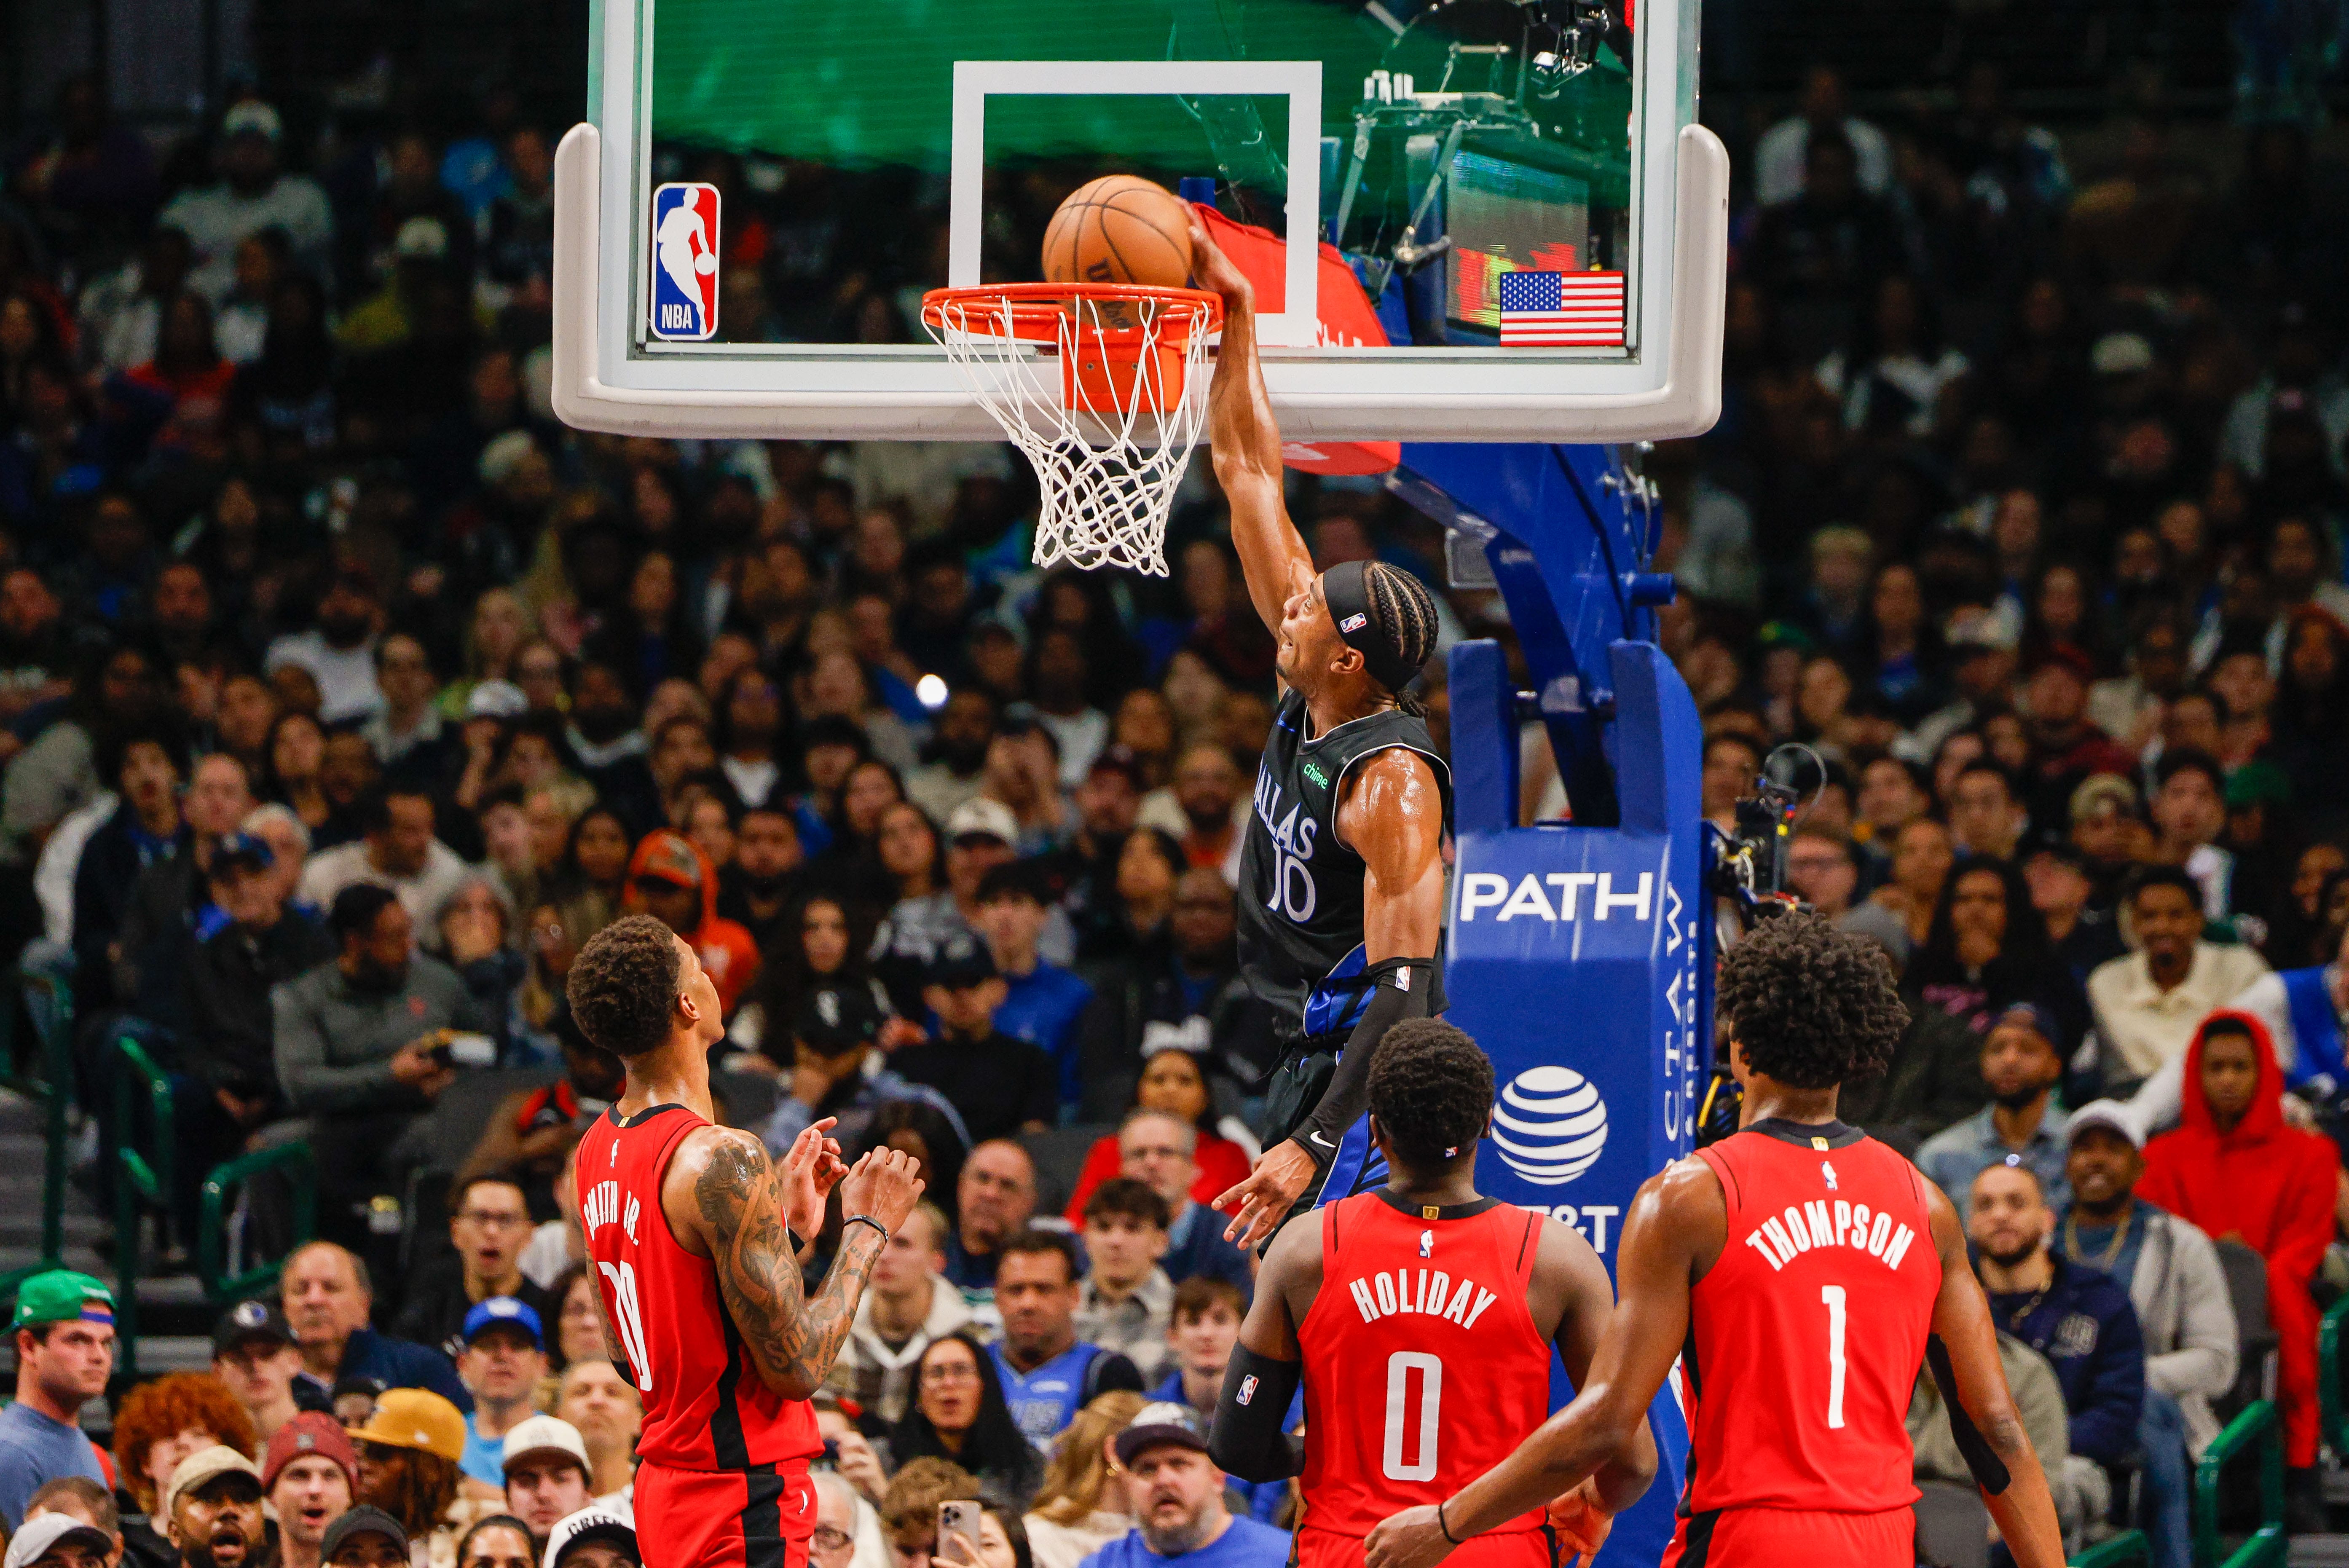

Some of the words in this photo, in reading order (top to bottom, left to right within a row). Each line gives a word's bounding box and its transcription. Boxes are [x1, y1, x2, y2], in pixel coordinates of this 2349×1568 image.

[661, 303, 692, 329] NBA
[1254, 752, 1318, 860] ALLAS
[1304, 762, 1328, 790] chime
[1267, 837, 1316, 923] 10
[1460, 872, 1653, 922] PATH
[1664, 880, 1683, 1169] CTAW
[583, 1180, 618, 1241] SMITH
[623, 1190, 640, 1246] JR.
[1745, 1199, 1915, 1272] THOMPSON
[1349, 1268, 1497, 1330] HOLIDAY
[1821, 1285, 1847, 1429] 1
[1383, 1351, 1442, 1482] 0
